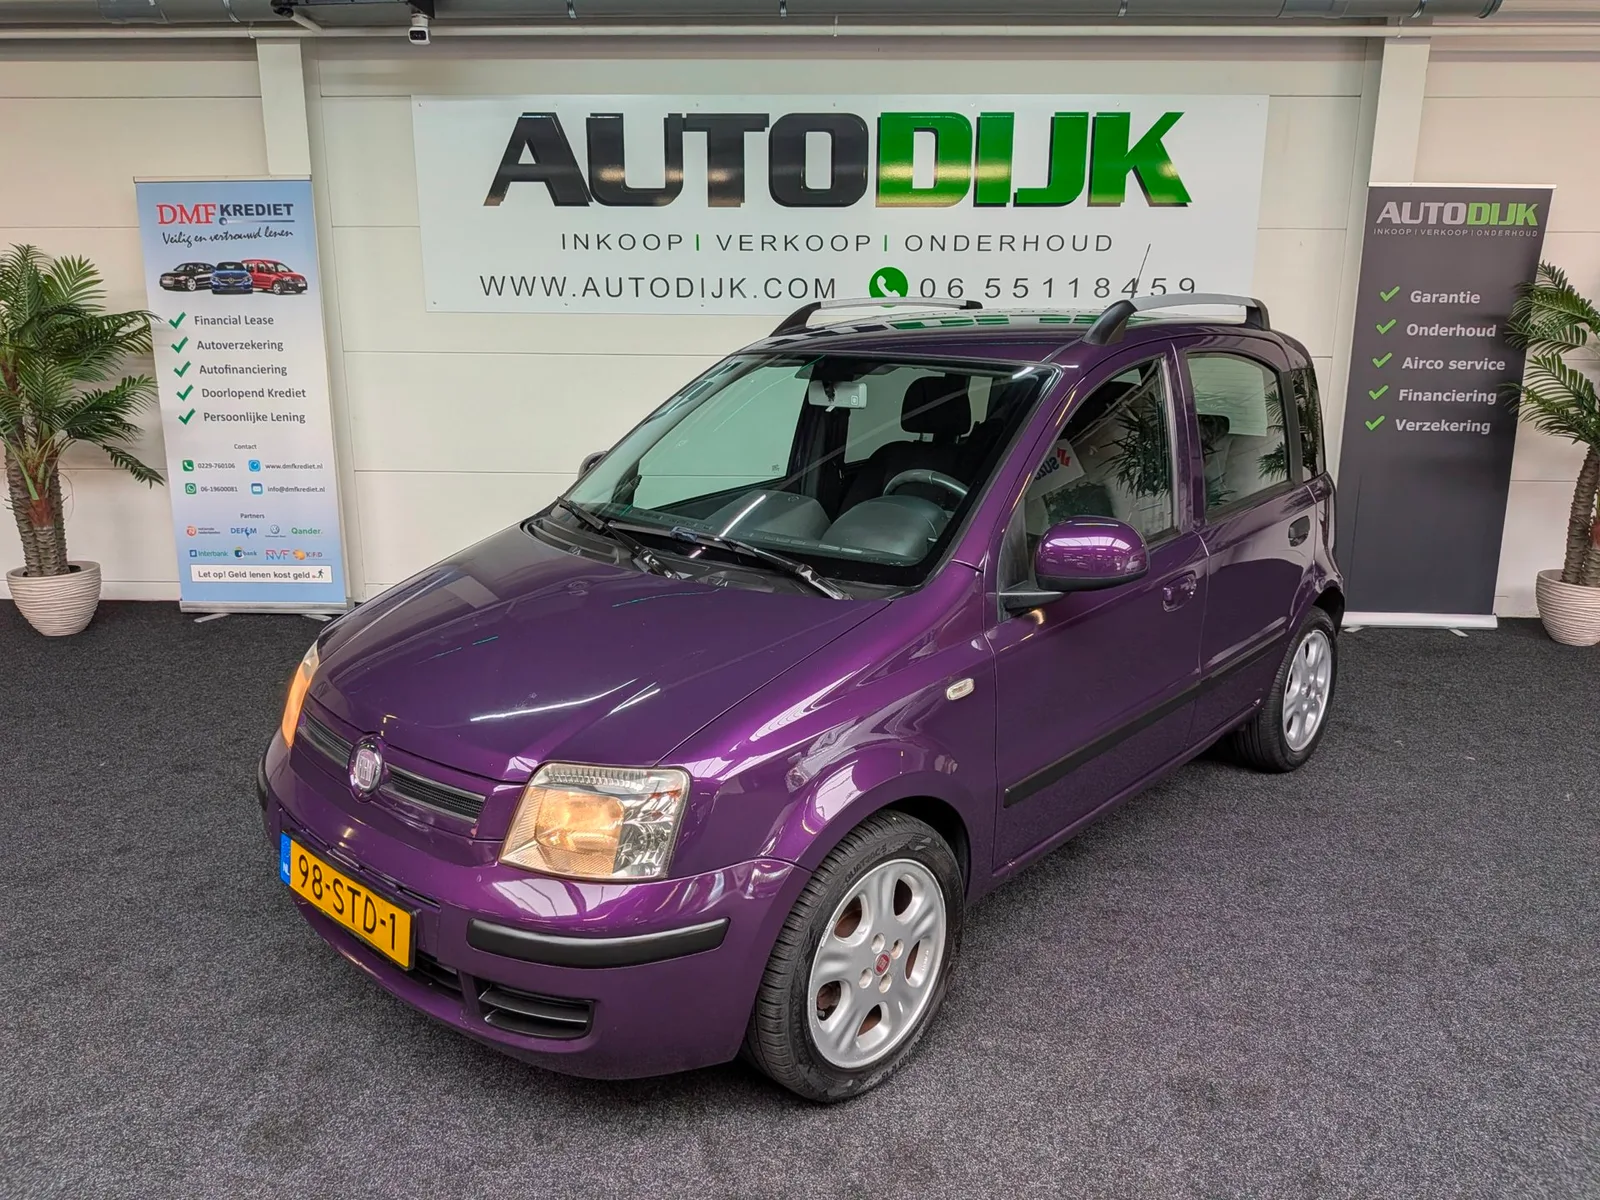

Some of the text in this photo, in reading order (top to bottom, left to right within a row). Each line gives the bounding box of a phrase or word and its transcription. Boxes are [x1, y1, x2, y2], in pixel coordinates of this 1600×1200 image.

[483, 112, 1193, 208] AUTODIJK
[156, 203, 294, 225] DMF KREDIET
[1375, 201, 1539, 226] AUTODIJK
[162, 226, 294, 248] Veilig en vertrouwd lenen
[1373, 228, 1538, 238] INKOOP VERKOOP ONDERHOUD
[560, 233, 1113, 252] INKOOP VERKOOP ONDERHOUD
[479, 275, 836, 299] WWW.AUTODIJK.COM
[919, 277, 965, 299] 06
[1410, 290, 1481, 304] Garantie
[194, 315, 275, 326] Financial Lease
[1406, 323, 1497, 338] Onderhoud
[196, 339, 284, 352] Autoverzekering
[199, 364, 288, 376] Autofinanciering
[1401, 356, 1506, 371] Airco service
[201, 388, 307, 400] Doorlopend Krediet
[1398, 388, 1497, 405] Financiering
[203, 411, 306, 424] Persoonlijke Lening
[1395, 418, 1491, 435] Verzekering
[265, 463, 323, 471] www.dmfkrediet.nl
[267, 486, 326, 494] info@dmfkrediet.nl
[240, 512, 266, 520] Partners
[198, 549, 229, 558] Interbank
[197, 570, 311, 581] Let op! Geld lenen kost geld
[282, 861, 291, 876] NL
[298, 853, 397, 952] 98-STD-1
